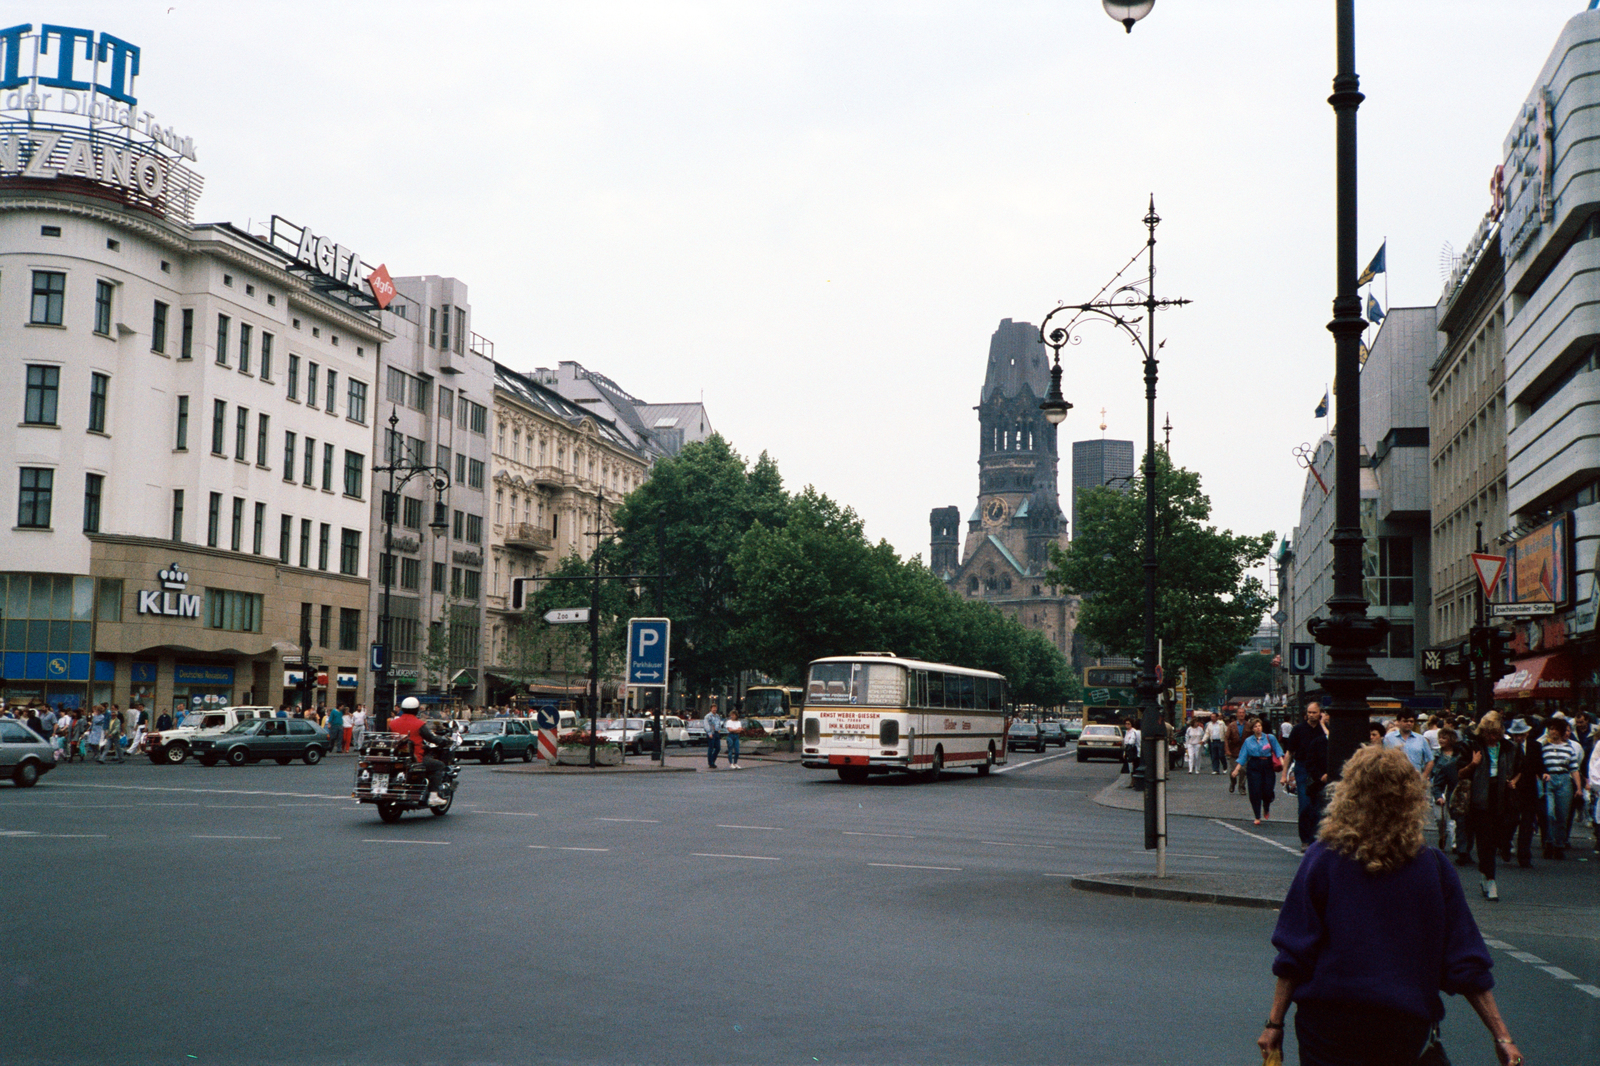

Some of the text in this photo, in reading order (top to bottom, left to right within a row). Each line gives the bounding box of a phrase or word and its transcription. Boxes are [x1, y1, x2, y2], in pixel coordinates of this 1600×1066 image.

[6, 86, 51, 110] der
[297, 226, 363, 292] AGFA
[373, 276, 393, 295] Agfa
[138, 590, 200, 617] KLM
[557, 612, 568, 620] Zoo
[638, 628, 659, 657] P
[632, 660, 663, 668] Parkhäuser
[1294, 648, 1310, 670] U
